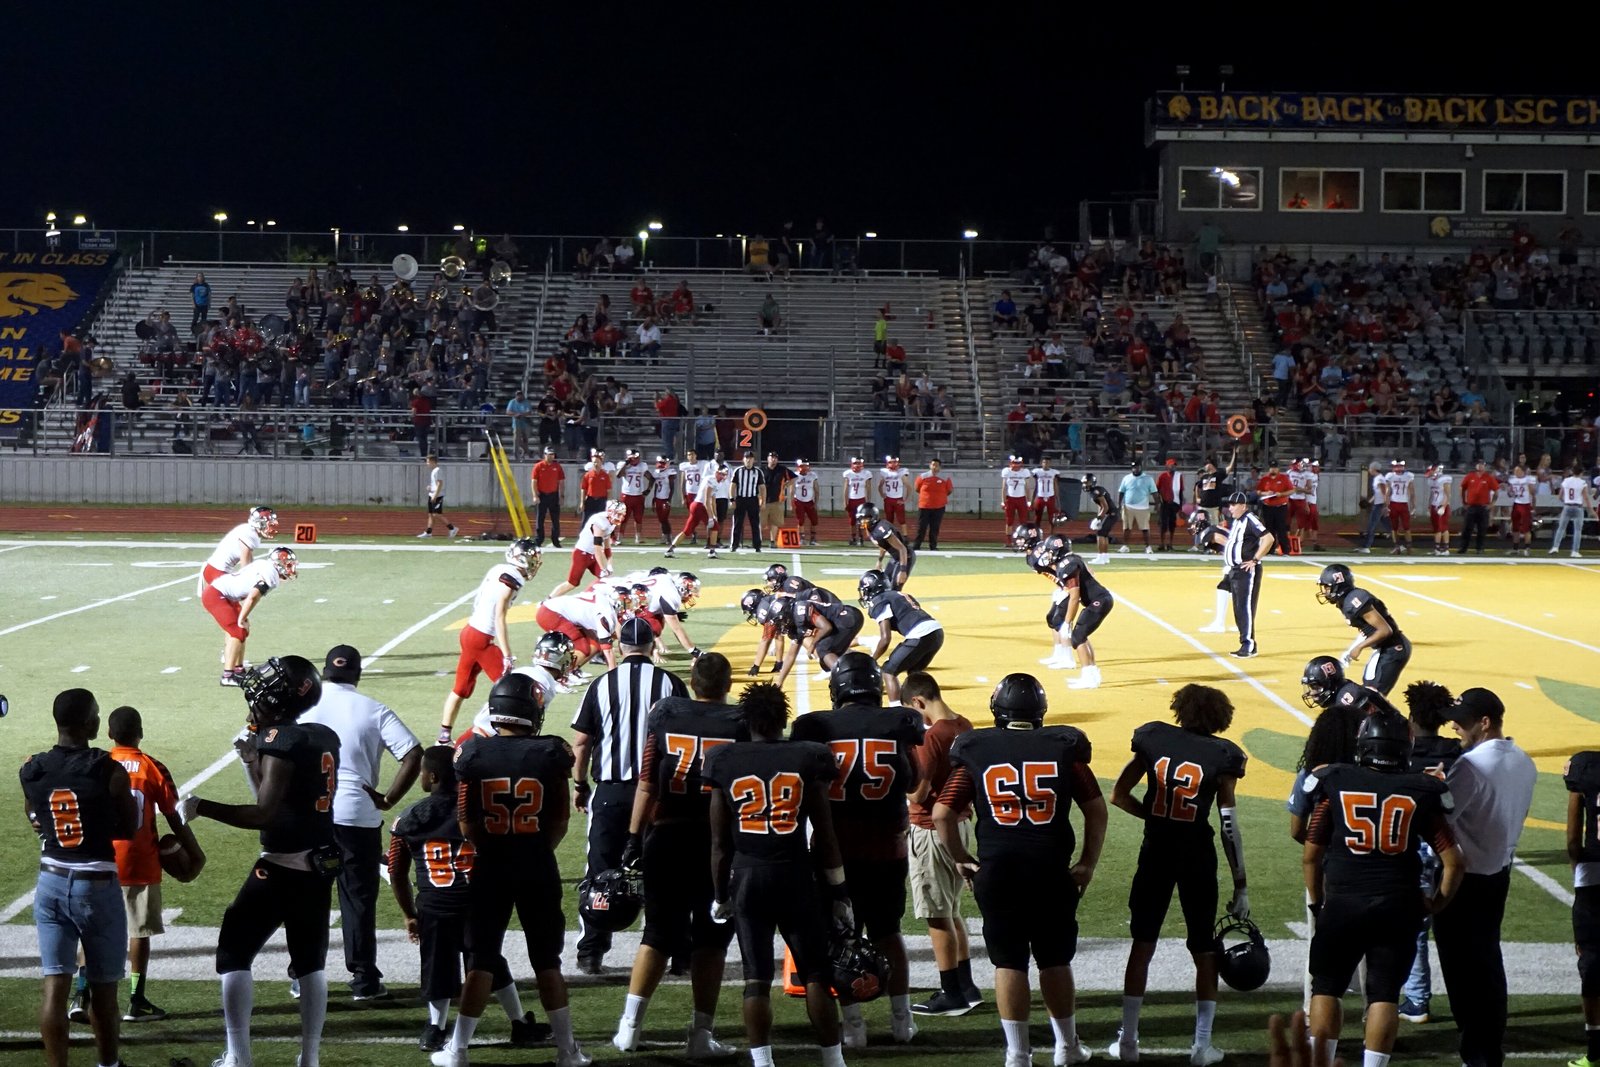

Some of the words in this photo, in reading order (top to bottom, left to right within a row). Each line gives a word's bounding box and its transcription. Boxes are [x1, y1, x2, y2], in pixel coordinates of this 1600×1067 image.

[1198, 96, 1280, 121] BACK
[1284, 102, 1298, 114] to
[1301, 97, 1384, 121] BACK
[1387, 103, 1401, 115] to
[1404, 98, 1487, 122] BACK
[1496, 98, 1558, 124] LSC
[13, 252, 36, 264] IN
[41, 252, 109, 265] CLASS
[740, 430, 752, 447] 2
[627, 475, 642, 488] 75
[853, 482, 860, 495] 4
[886, 480, 899, 493] 54
[1013, 480, 1020, 491] 7
[1568, 488, 1575, 501] 8
[296, 526, 313, 541] 20
[782, 531, 798, 545] 30
[333, 657, 347, 666] C
[265, 728, 279, 743] 3
[828, 738, 897, 801] 75
[315, 751, 336, 813] 3
[1151, 756, 1204, 822] 12
[983, 761, 1058, 826] 65
[481, 777, 544, 834] 52
[730, 771, 804, 835] 28
[49, 788, 84, 848] 8
[1339, 791, 1417, 855] 50
[255, 868, 269, 880] C
